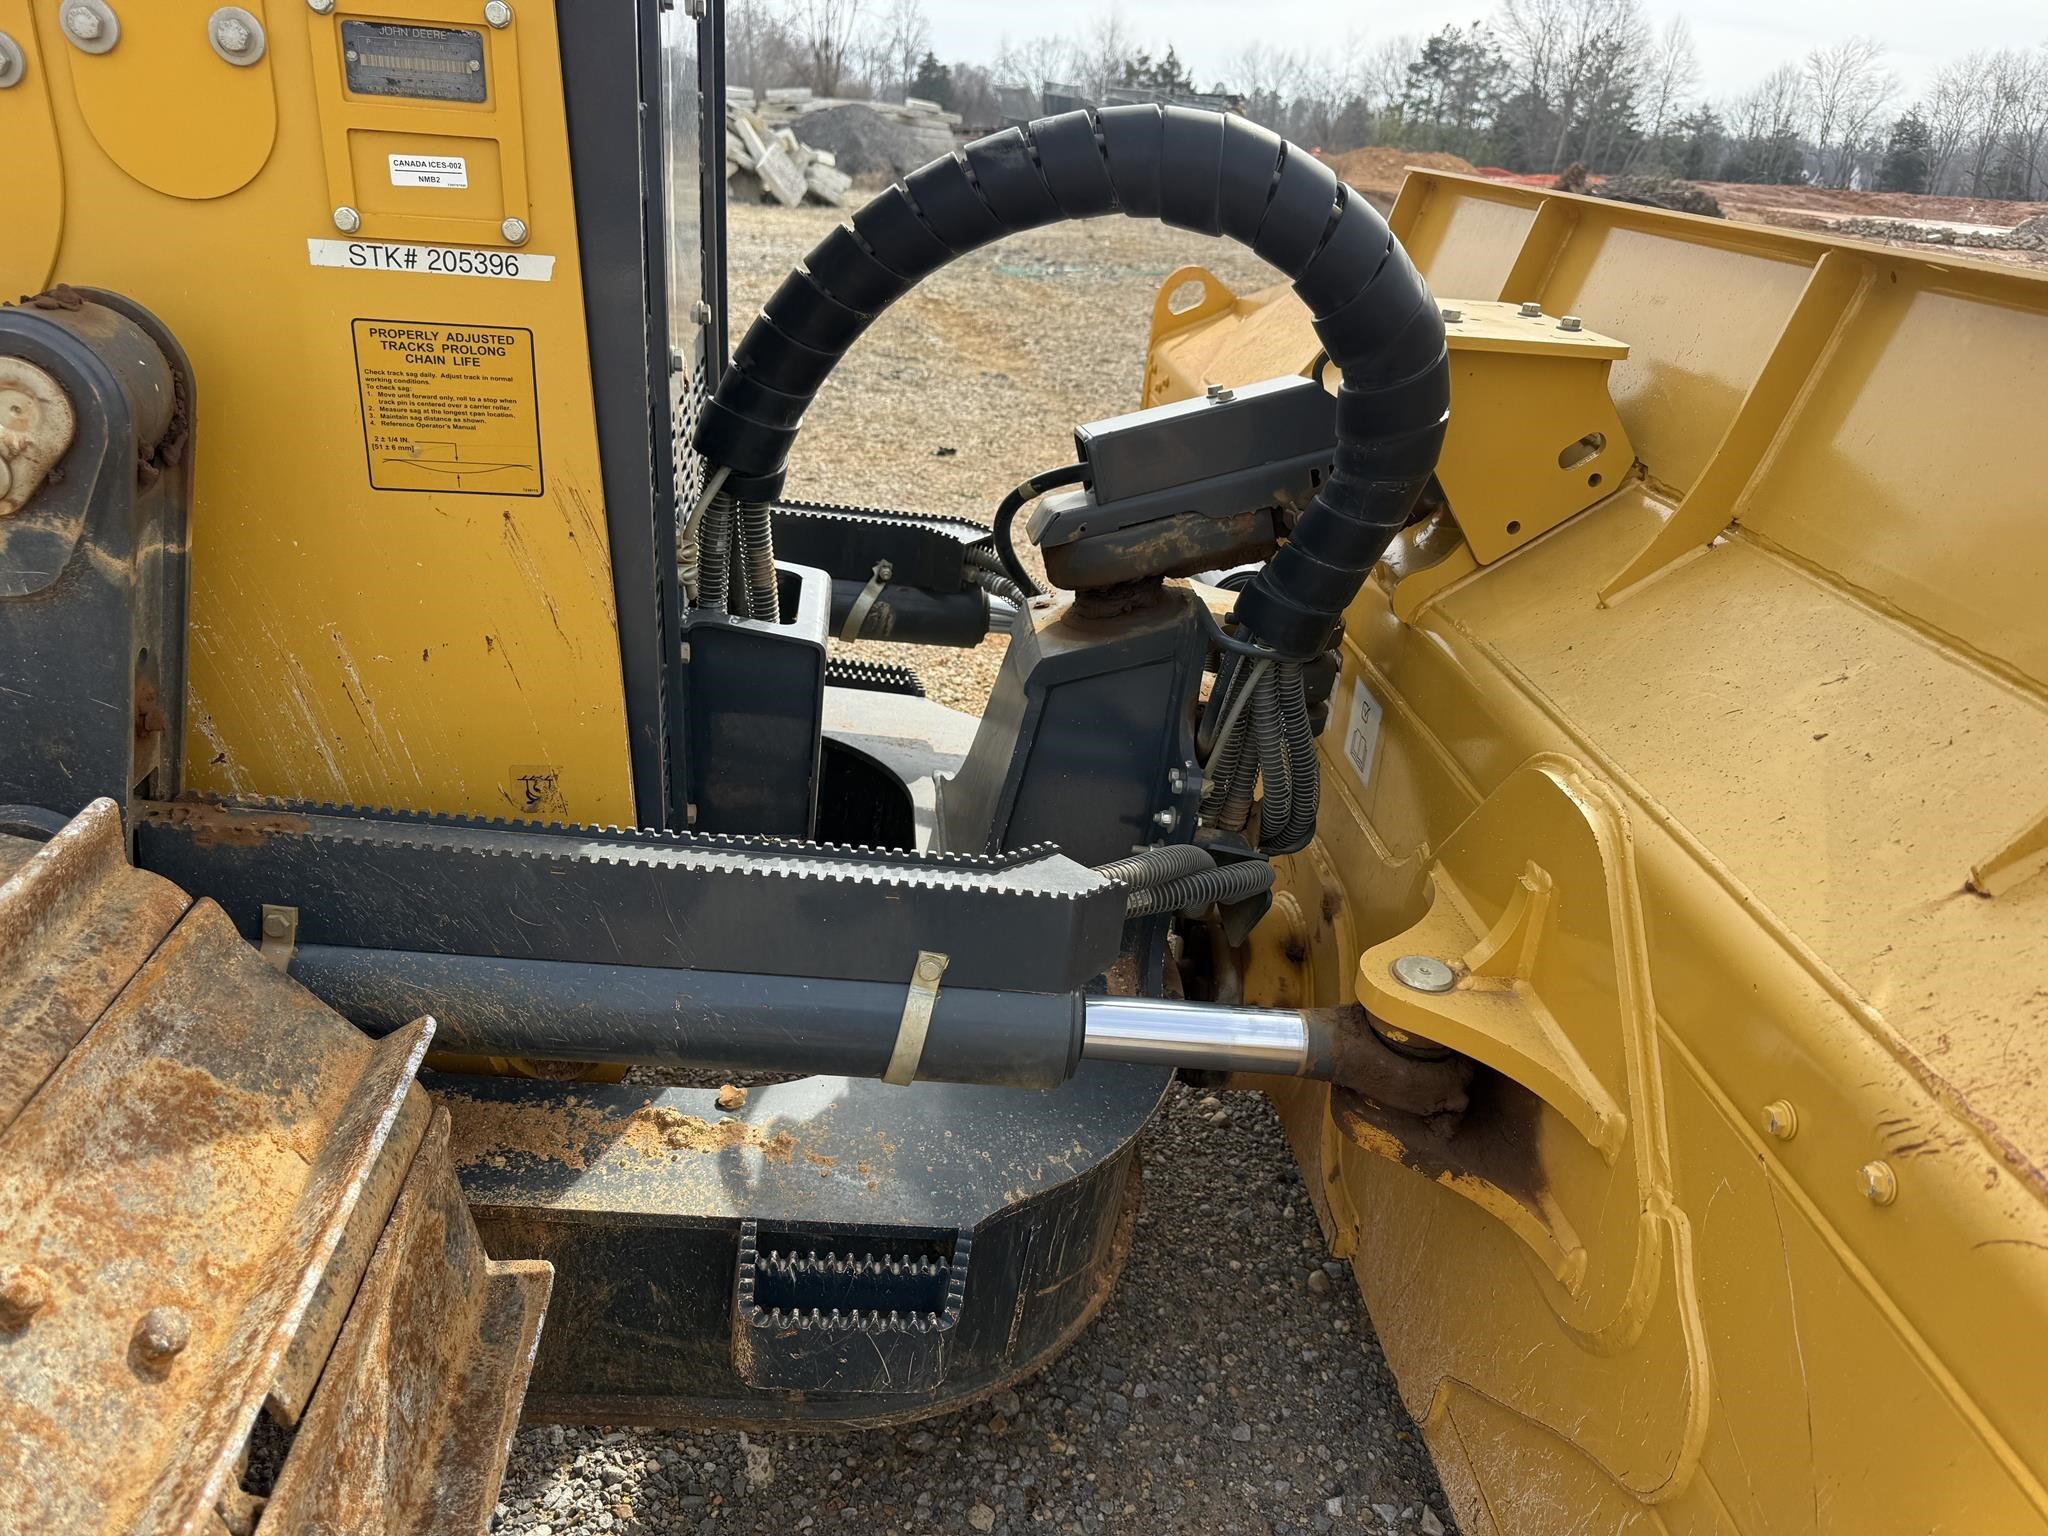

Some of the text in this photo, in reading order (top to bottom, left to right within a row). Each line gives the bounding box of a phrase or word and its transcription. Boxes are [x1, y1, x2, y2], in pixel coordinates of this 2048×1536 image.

[379, 26, 448, 40] JOHN DEERE
[393, 160, 427, 168] CANADA
[348, 244, 519, 276] STK# 205396
[370, 328, 515, 345] PROPERLY ADJUSTED
[380, 340, 506, 356] TRACKS PROLONG
[406, 354, 480, 367] CHAIN LIFE
